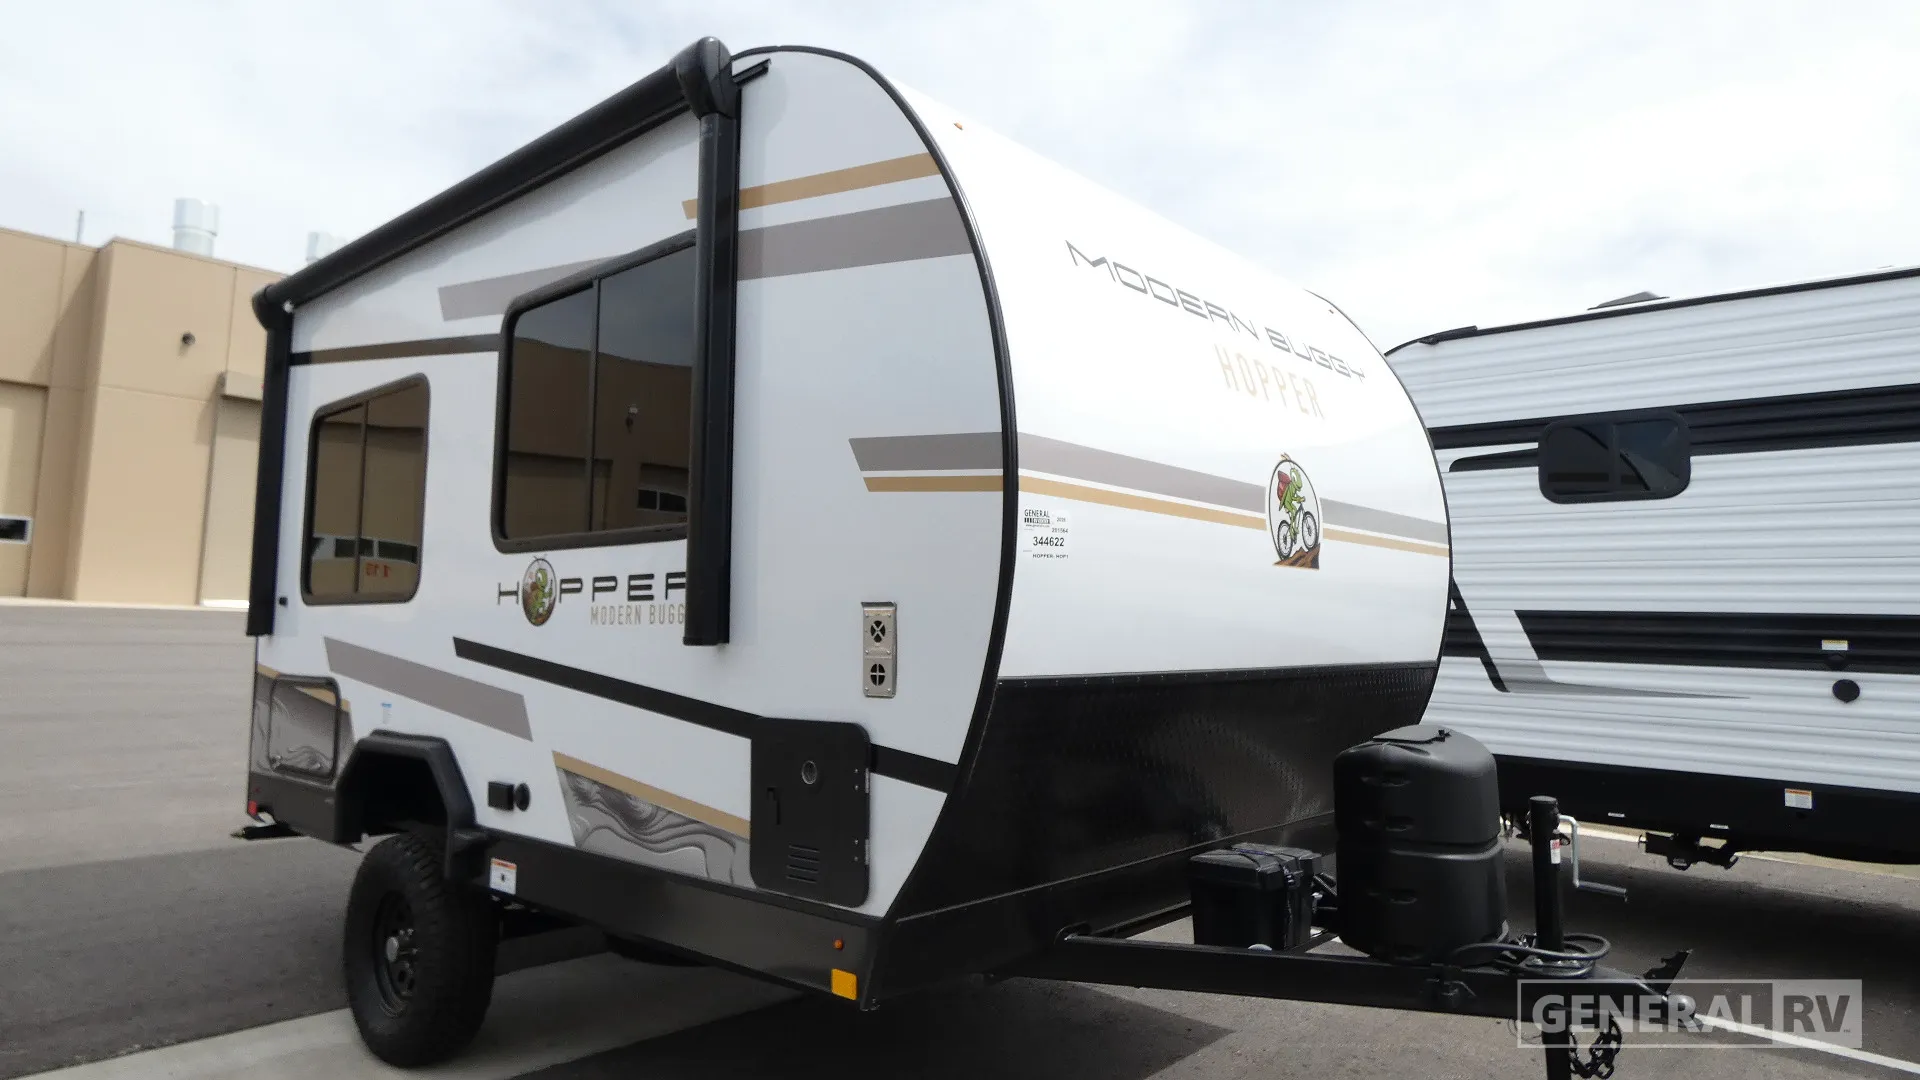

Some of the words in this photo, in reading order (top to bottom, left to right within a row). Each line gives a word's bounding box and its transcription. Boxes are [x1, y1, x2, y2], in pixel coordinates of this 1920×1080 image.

[1065, 239, 1260, 341] MODERN
[1264, 326, 1366, 383] BUGGY
[1214, 343, 1325, 421] HOPPER
[1024, 509, 1050, 517] GENERAL
[1033, 536, 1065, 547] 344622
[590, 605, 642, 625] MODERN
[649, 603, 685, 625] BUGG
